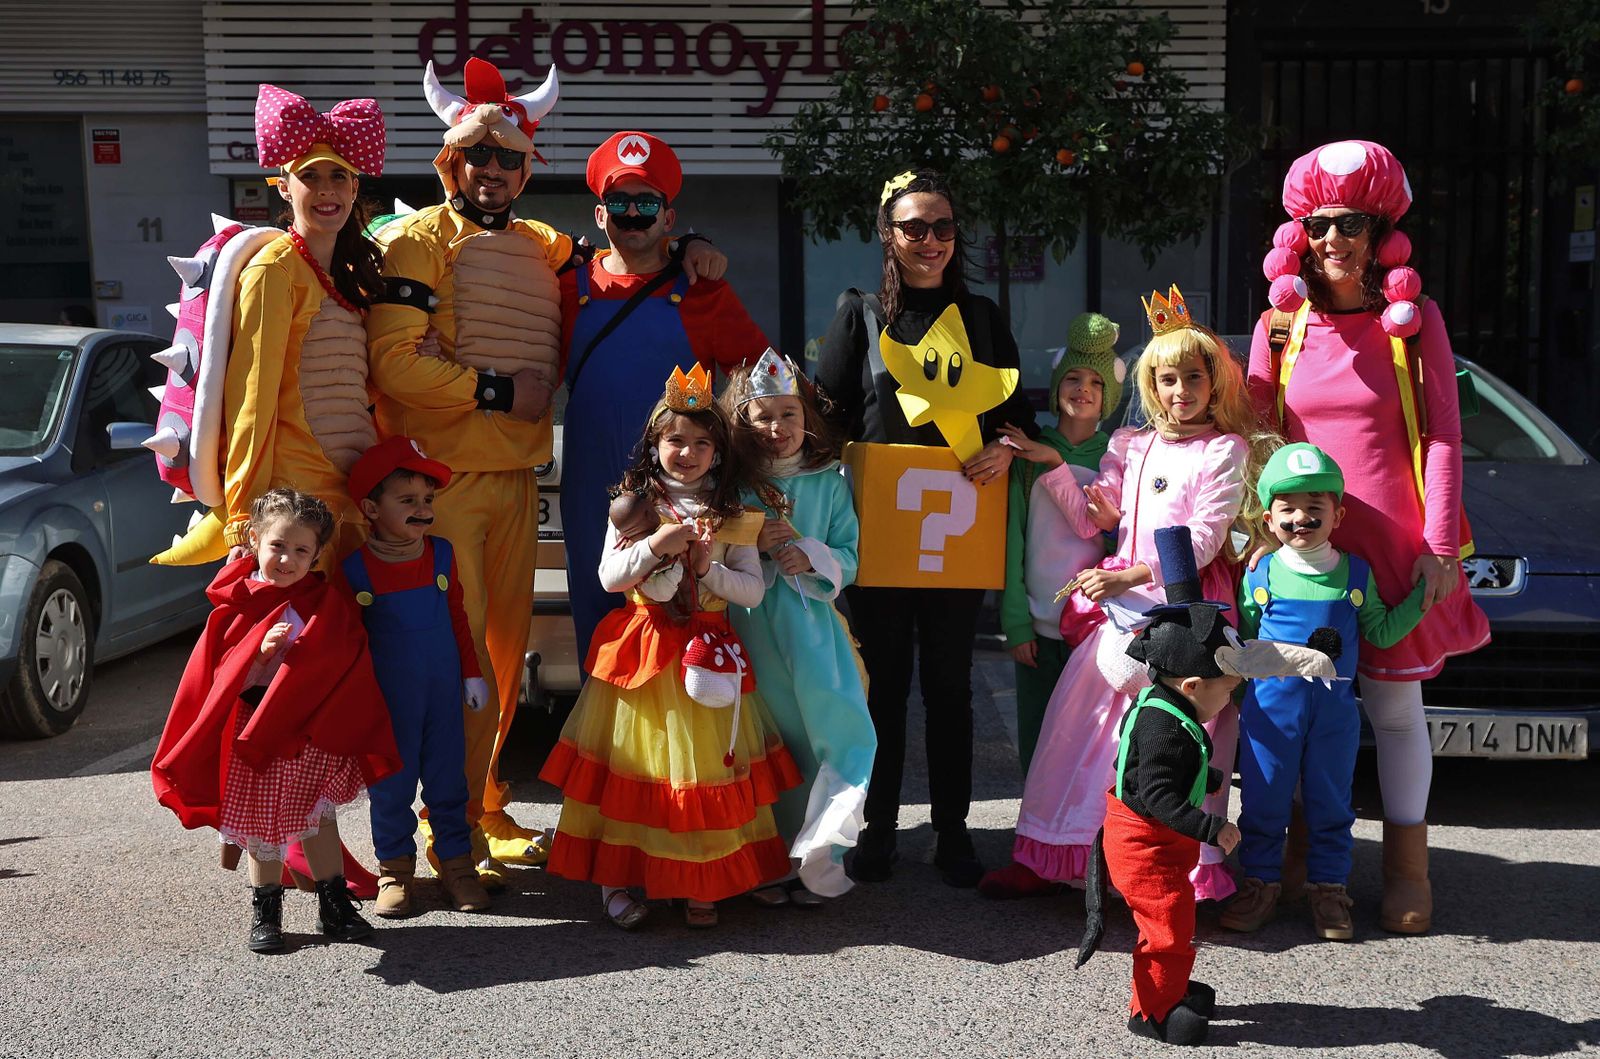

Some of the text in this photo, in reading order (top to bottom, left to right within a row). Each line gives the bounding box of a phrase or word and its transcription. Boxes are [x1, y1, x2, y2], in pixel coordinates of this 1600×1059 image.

[53, 69, 171, 86] 956 11 48 75
[227, 141, 257, 160] Ca
[620, 141, 648, 158] M
[136, 217, 163, 242] 11
[1296, 454, 1312, 469] L
[1515, 722, 1577, 753] DNM
